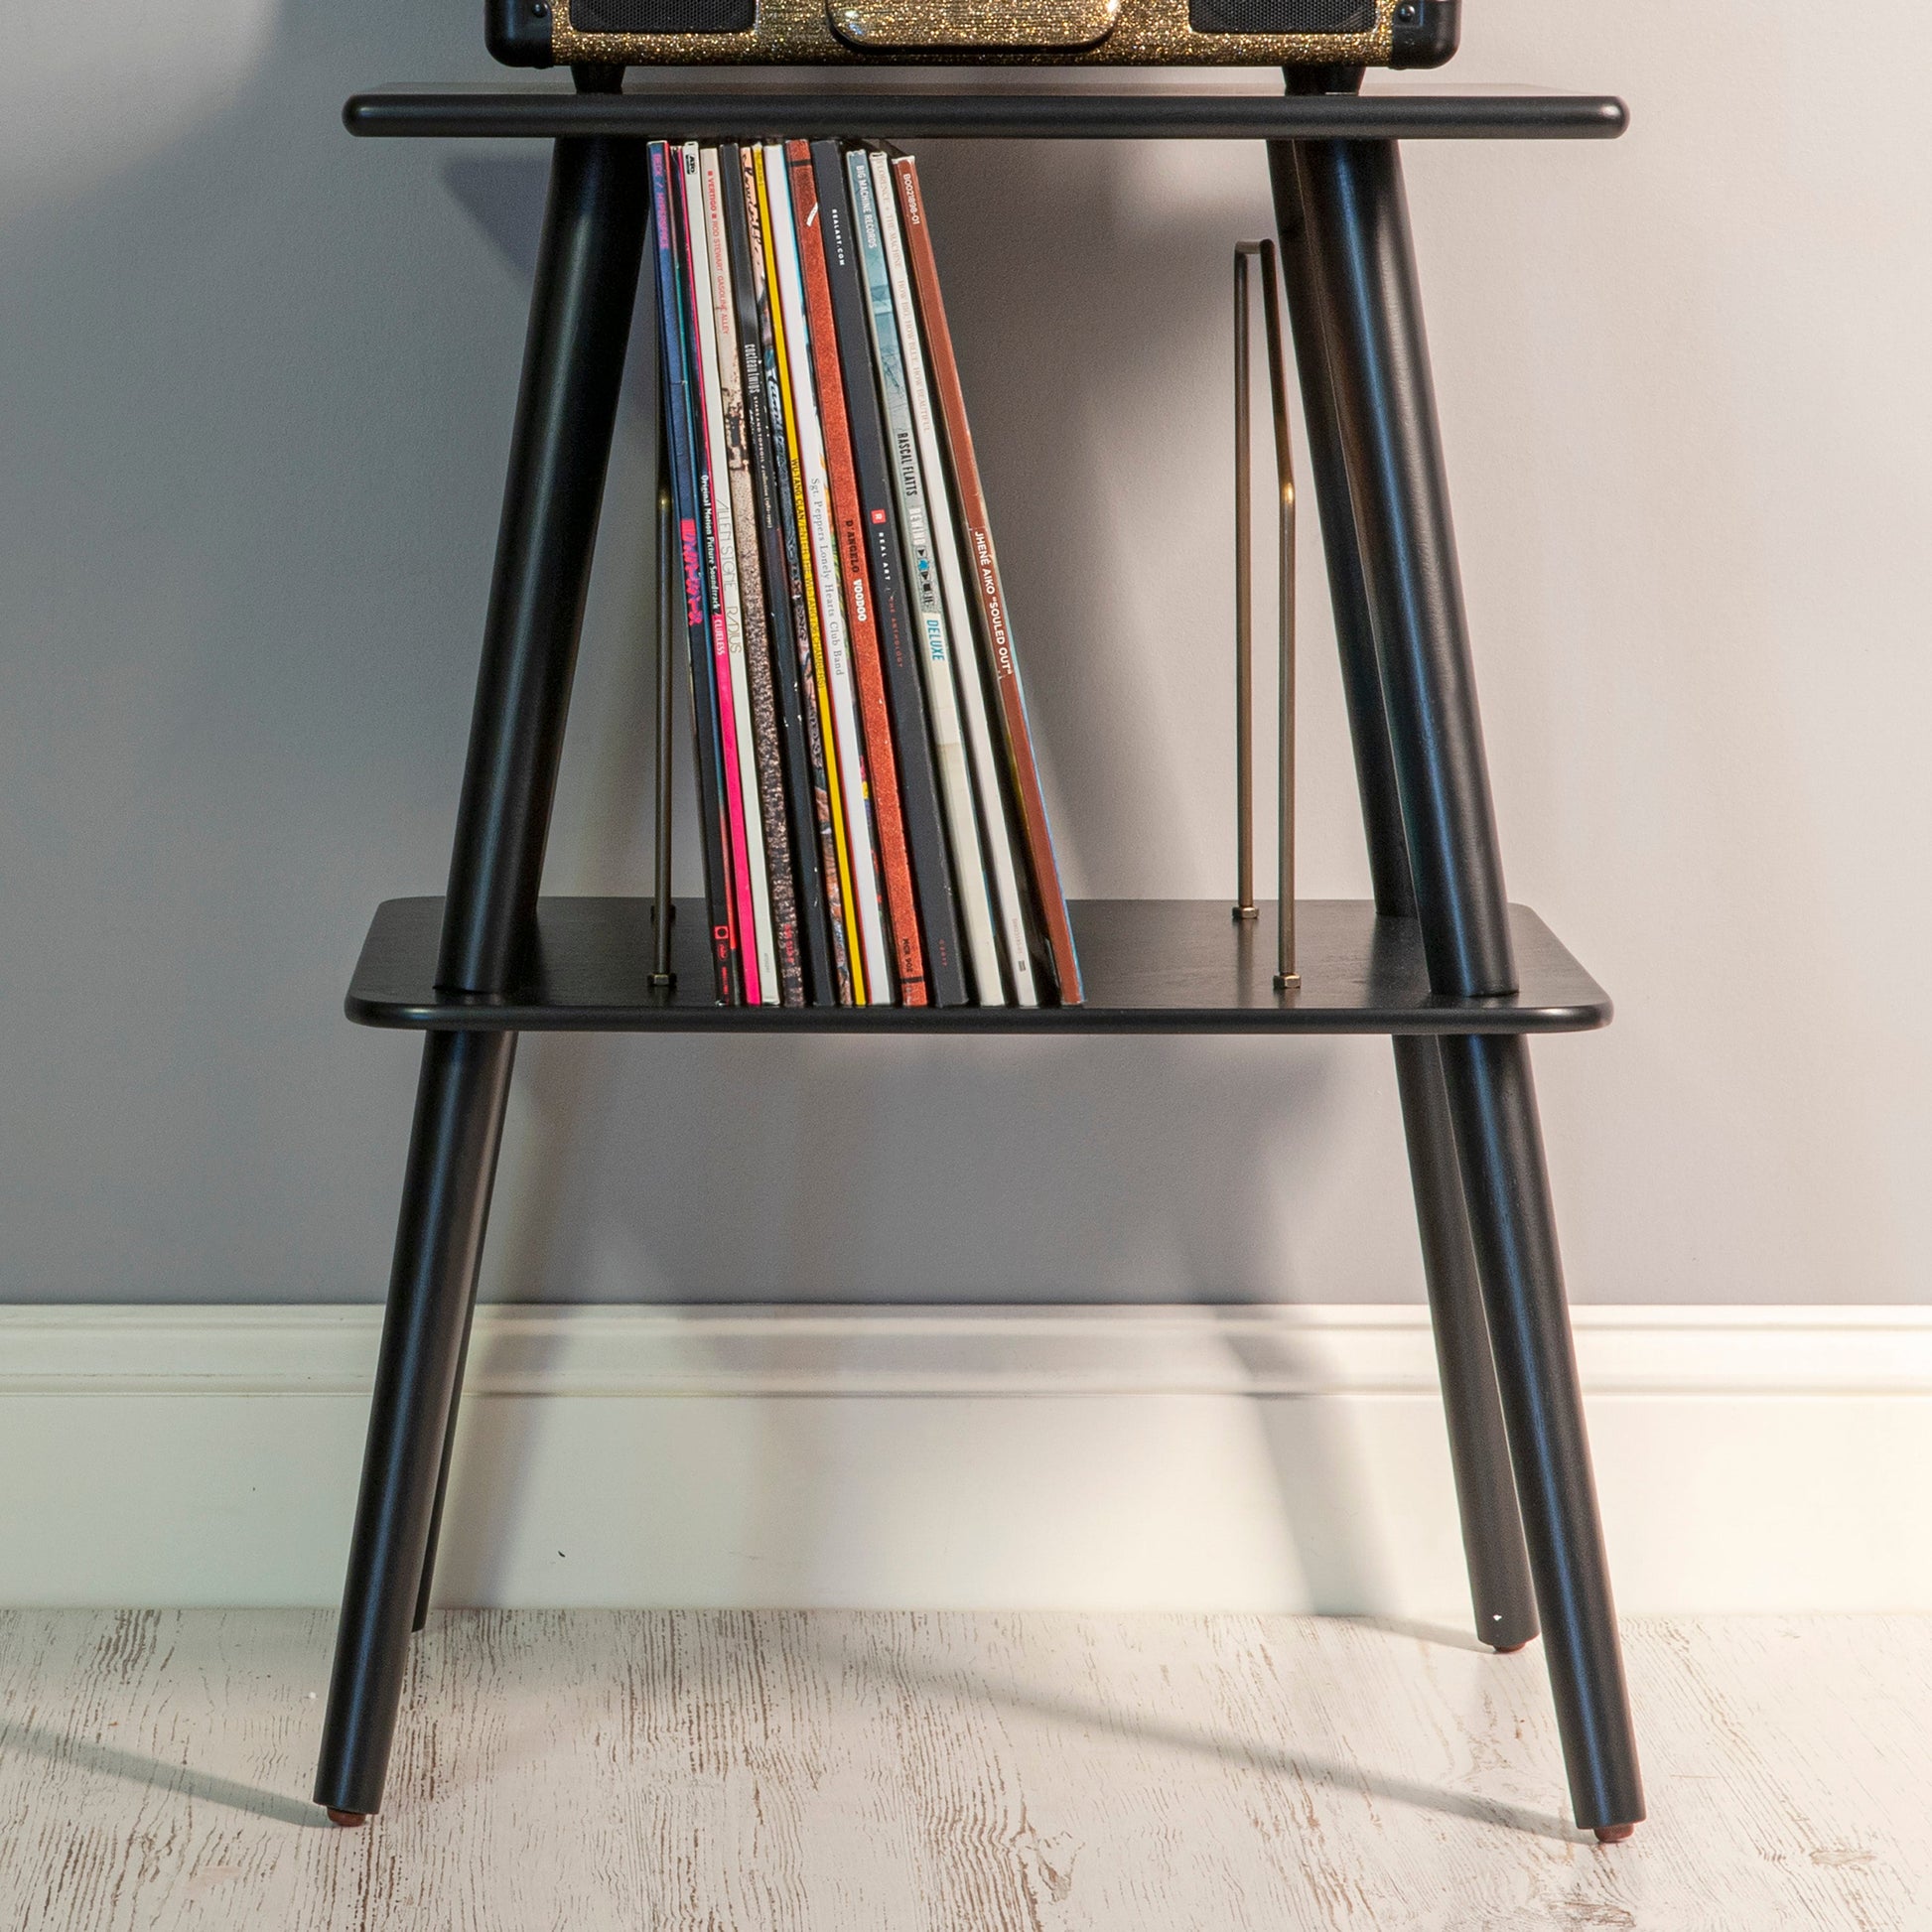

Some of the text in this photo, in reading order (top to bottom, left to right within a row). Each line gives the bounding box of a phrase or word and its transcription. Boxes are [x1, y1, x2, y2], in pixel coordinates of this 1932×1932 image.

[652, 153, 662, 176] BECK
[655, 192, 668, 248] HYPERSPACE
[856, 165, 877, 247] BIG MACHINE RECORDS
[886, 214, 895, 229] THE
[831, 208, 845, 265] REALART.COM
[889, 232, 900, 267] MACHINE
[744, 344, 759, 372] cocteau
[748, 372, 761, 393] twins
[916, 388, 932, 432] BEAUTIFUL
[790, 459, 802, 495] WU-TANG
[897, 432, 917, 496] RASCAL FLATTS
[700, 475, 711, 505] Original
[704, 507, 713, 534] Motion
[908, 506, 925, 545] REWIND
[876, 531, 889, 557] REAL
[974, 529, 991, 565] JHENÉ
[710, 566, 720, 609] Soundtrack
[716, 497, 742, 654] ALLEN STONE RADIUS
[808, 478, 843, 675] Sgt. Peppers Lonely Hearts Club Band
[845, 519, 867, 621] D'ANGELO VOODOO
[882, 562, 892, 580] ART
[982, 567, 995, 595] AIKO
[715, 620, 724, 655] CLUELESS
[890, 618, 905, 667] ANTHOLOGY
[926, 618, 944, 662] DELUXE
